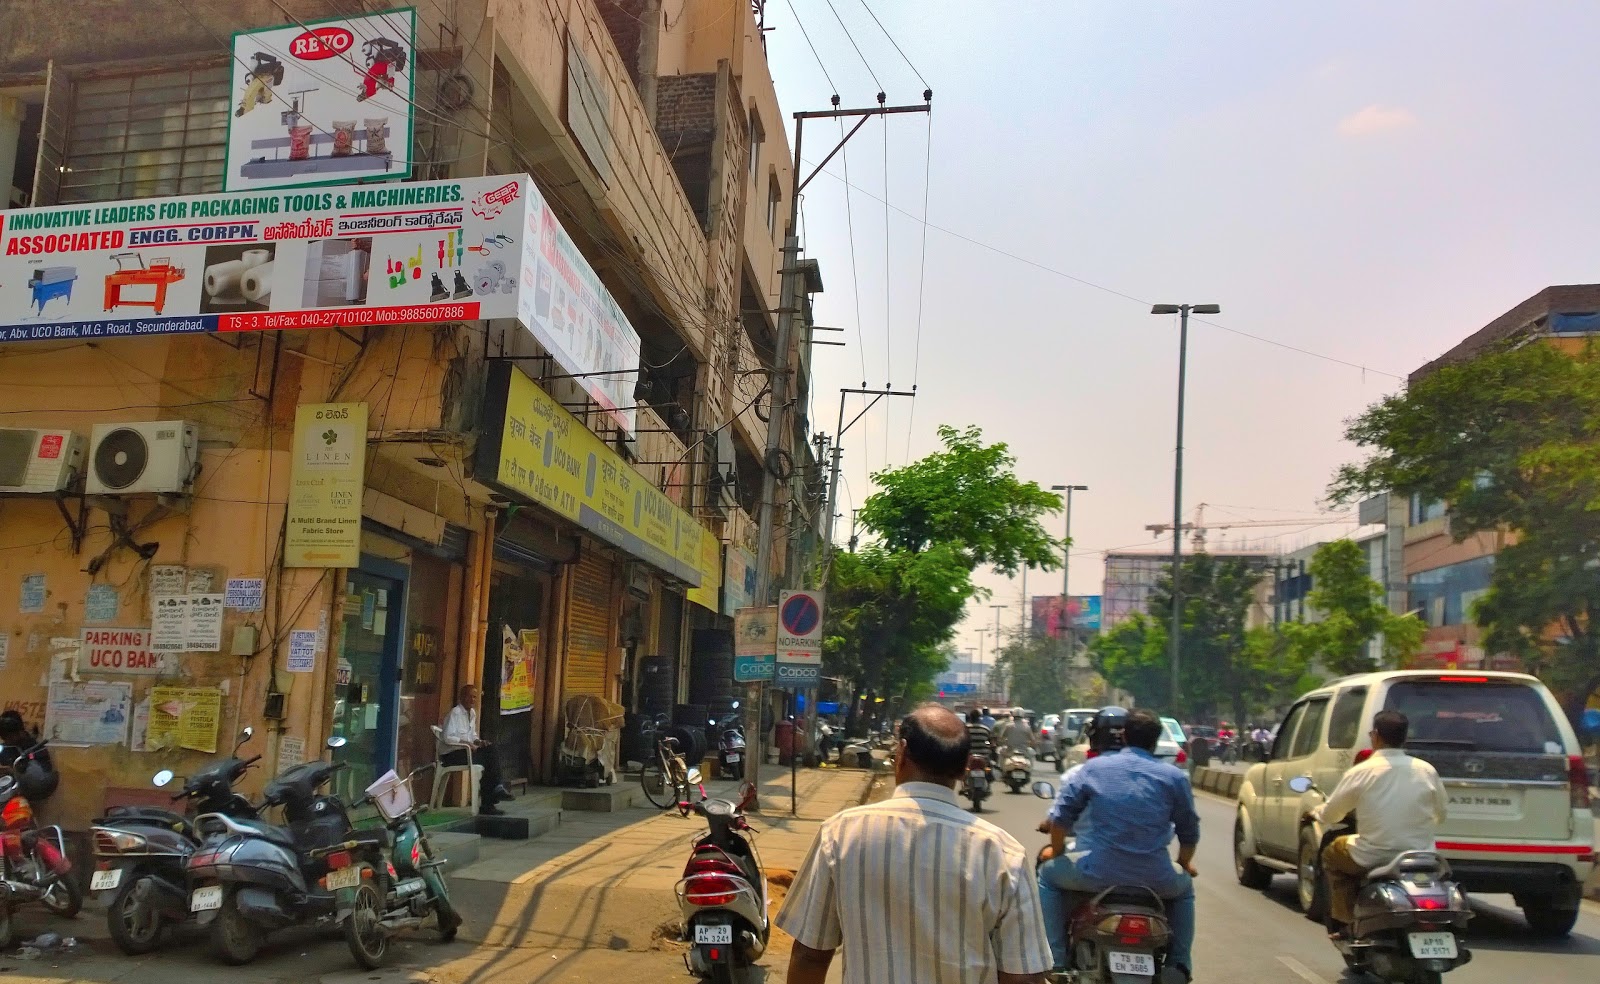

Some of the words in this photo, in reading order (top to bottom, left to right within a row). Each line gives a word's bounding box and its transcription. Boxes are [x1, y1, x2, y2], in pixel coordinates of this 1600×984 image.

[295, 34, 348, 54] REVO
[9, 210, 91, 230] INNOVATIVE
[94, 204, 156, 225] LEADERS
[159, 202, 187, 220] FOR
[191, 196, 279, 218] PACKAGING
[284, 193, 332, 212] TOOLS
[336, 193, 346, 210] &
[352, 185, 464, 208] MACHINERIES.
[6, 230, 124, 256] ASSOCIATED
[130, 228, 182, 245] ENGG.
[188, 225, 258, 242] CORPN.
[10, 328, 28, 338] Abv.
[32, 327, 51, 338] UCO
[54, 324, 79, 338] Bank,
[82, 323, 103, 335] M.G.
[107, 322, 133, 335] Road,
[136, 319, 204, 332] Secunderabad.
[230, 317, 241, 328] TS
[252, 316, 260, 327] 3.
[264, 310, 297, 326] Tel/Fax:
[300, 311, 372, 326] 040-27710102
[306, 453, 350, 461] LINEN
[554, 446, 566, 468] UCO
[566, 454, 581, 480] BANK
[560, 490, 575, 514] ATM
[86, 632, 141, 646] PARKING
[91, 649, 122, 668] UCO
[127, 651, 157, 668] BAN
[741, 663, 774, 675] Capc
[778, 666, 817, 678] Capco
[1115, 963, 1126, 971] EN
